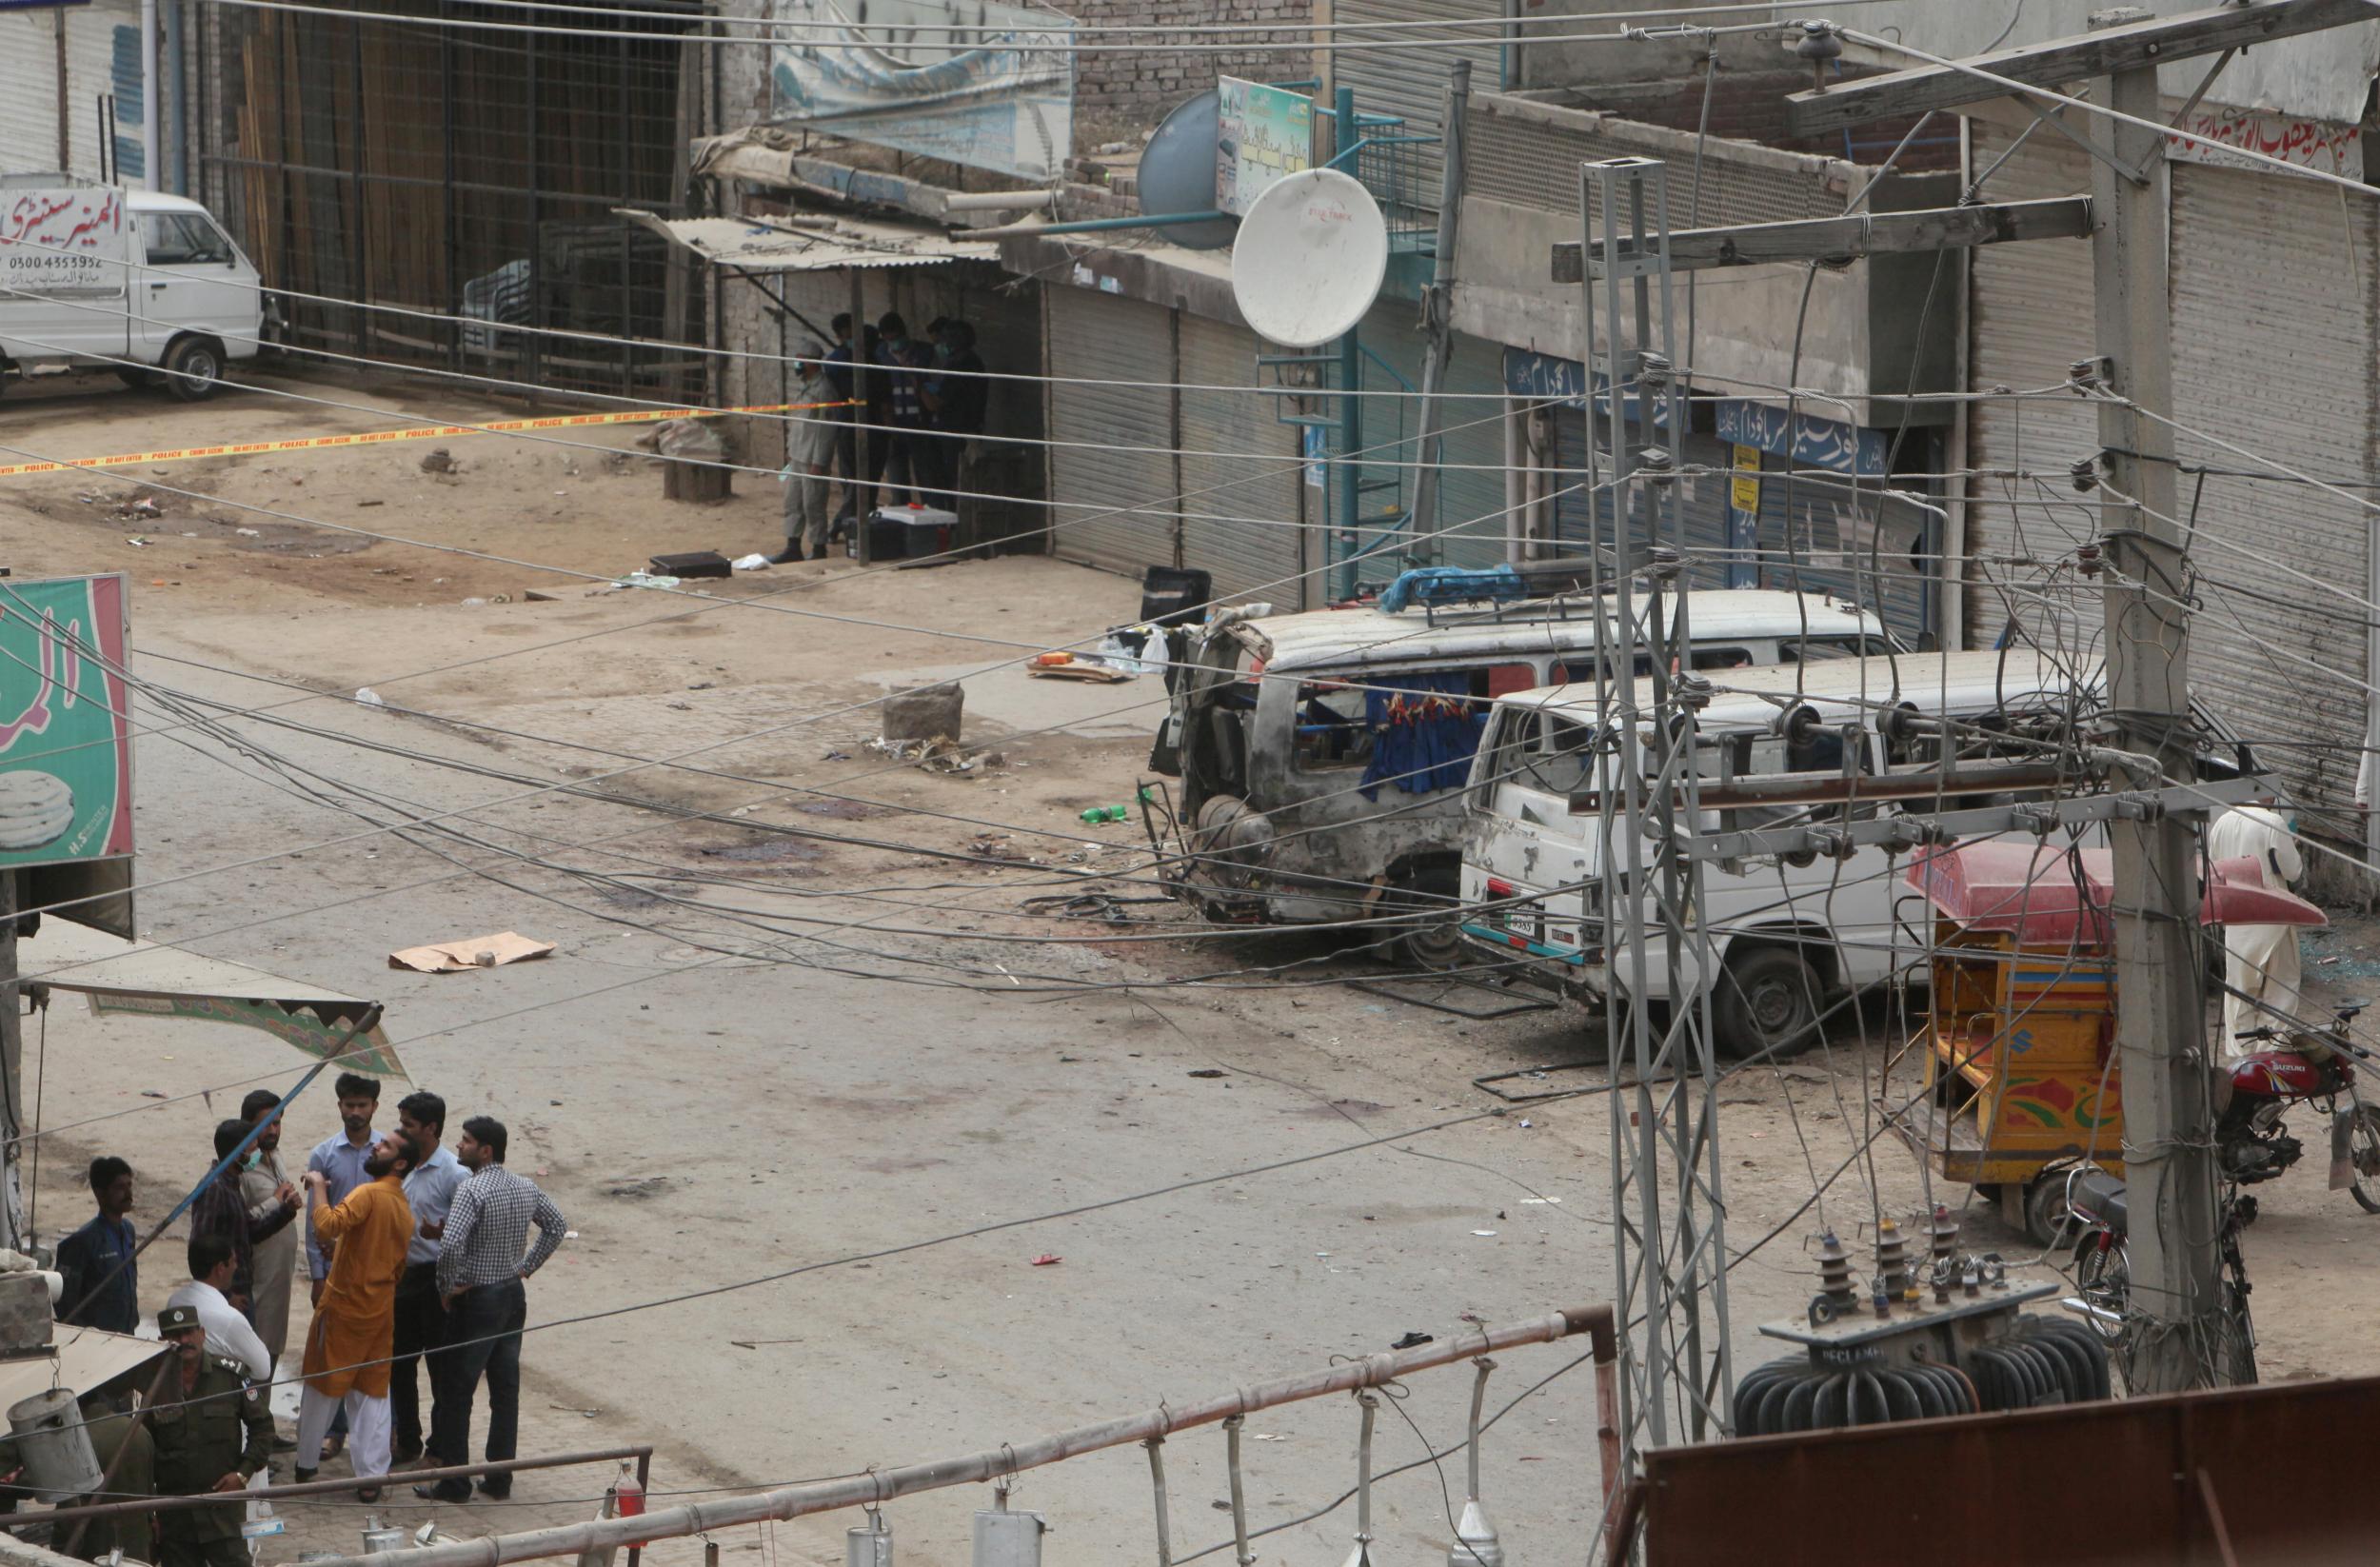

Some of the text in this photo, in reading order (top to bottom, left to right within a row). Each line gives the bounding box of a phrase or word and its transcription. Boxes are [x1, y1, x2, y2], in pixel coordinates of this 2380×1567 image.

[25, 464, 54, 472] POLICE
[151, 450, 183, 460] POLICE
[279, 440, 309, 448] POLICE
[406, 428, 435, 438] POLICE
[532, 418, 563, 427] POLICE
[2271, 1063, 2305, 1072] SUZUKI
